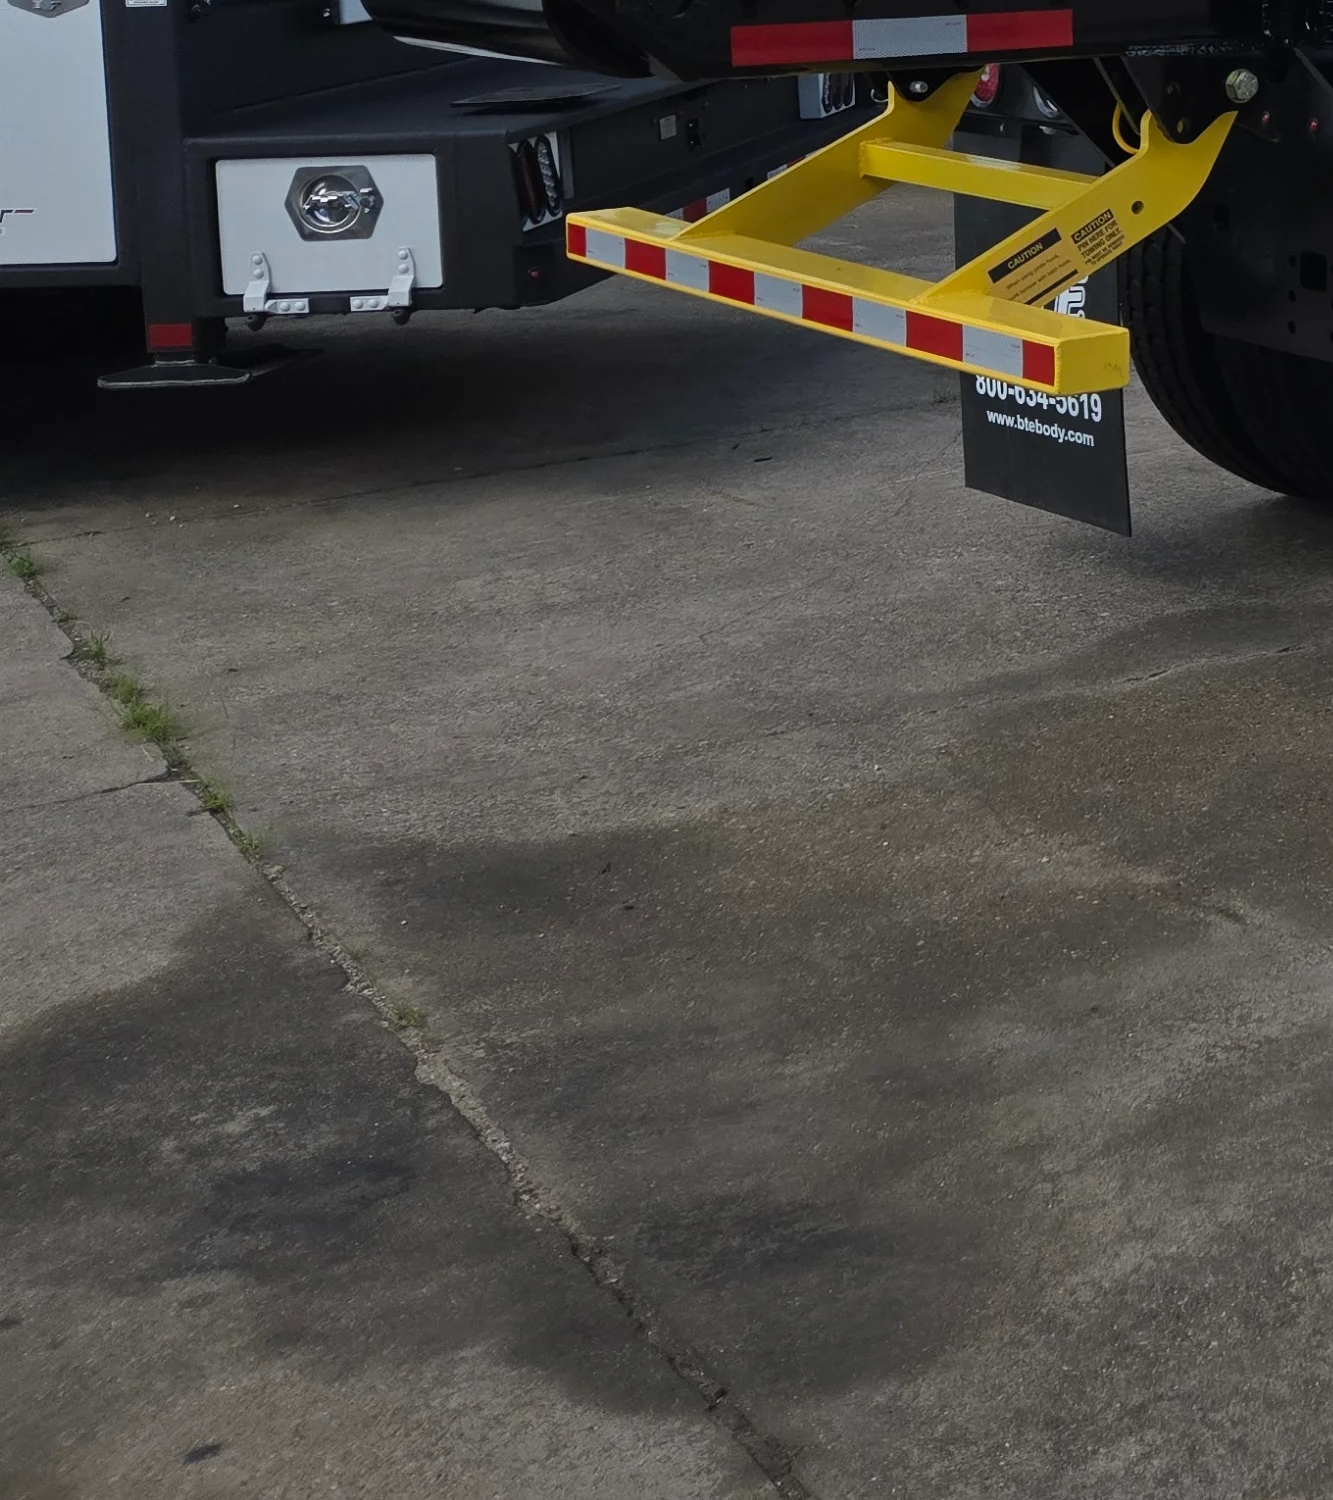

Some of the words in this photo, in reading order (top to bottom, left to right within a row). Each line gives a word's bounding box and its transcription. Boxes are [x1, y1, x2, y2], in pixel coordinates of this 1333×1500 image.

[1073, 211, 1112, 241] CAUTION
[1077, 241, 1090, 252] PIN
[1088, 229, 1105, 245] HERE
[1105, 219, 1118, 233] FOR
[1007, 242, 1044, 270] CAUTION
[1081, 239, 1106, 259] TOWING
[986, 409, 1095, 447] www.btebody.com
